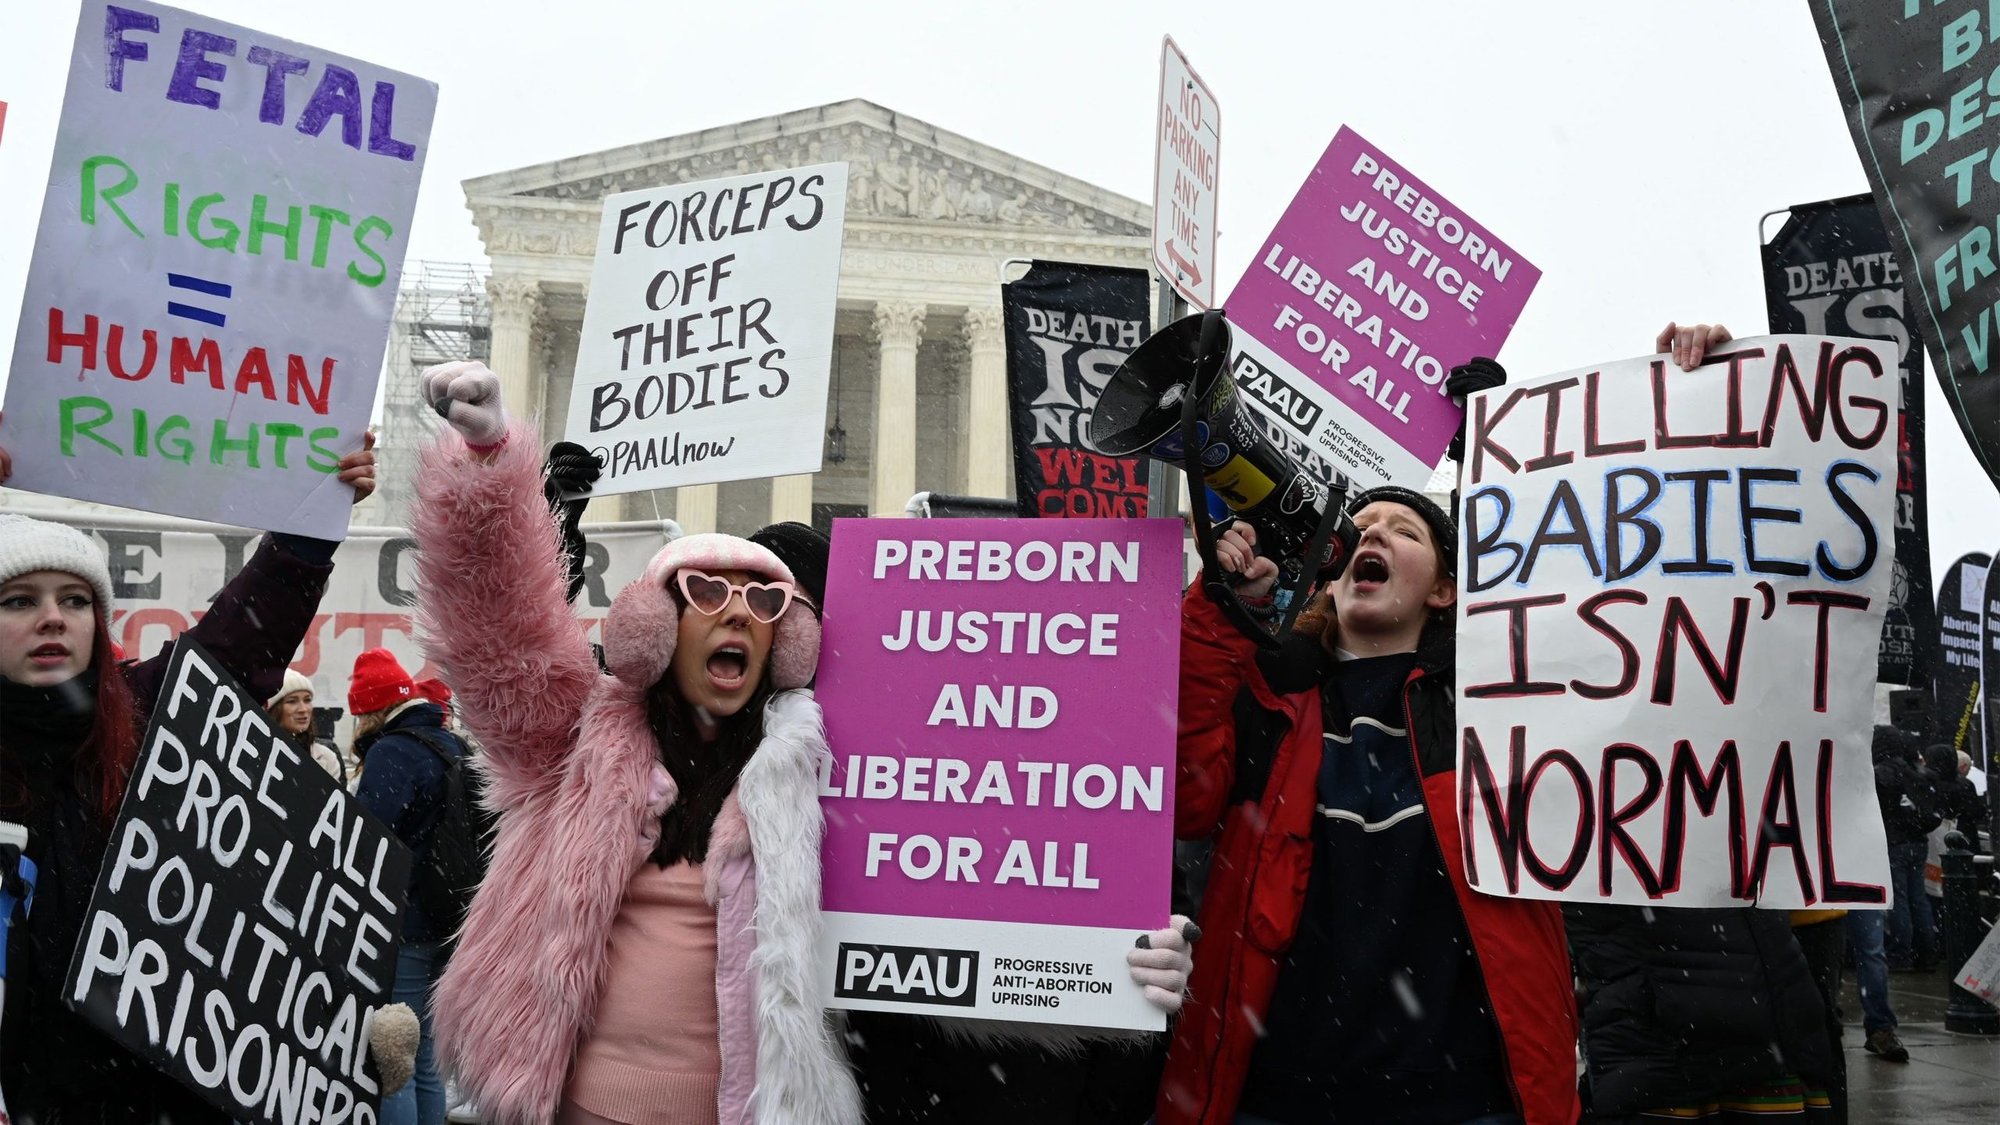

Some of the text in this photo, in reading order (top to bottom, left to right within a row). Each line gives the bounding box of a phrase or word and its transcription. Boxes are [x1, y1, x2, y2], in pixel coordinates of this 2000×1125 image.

[105, 5, 416, 161] FETAL
[1179, 77, 1201, 131] NO
[1164, 103, 1213, 192] PARKING
[613, 174, 824, 254] FORCEPS
[1173, 168, 1200, 215] ANY
[1351, 152, 1513, 284] PREBORN
[81, 156, 393, 288] RIGHTS
[1171, 199, 1200, 255] TIME
[646, 253, 735, 310] OFF
[1340, 200, 1483, 312] JUSTICE
[1784, 252, 1903, 297] DEATH
[1934, 214, 2000, 312] FR
[1347, 256, 1429, 321] AND
[612, 298, 778, 370] THEIR
[1023, 307, 1142, 348] DEATH
[47, 308, 337, 415] HUMAN
[1273, 305, 1411, 424] FOR ALL
[590, 349, 789, 433] BODIES
[1235, 357, 1317, 427] PAAU
[1470, 341, 1888, 483] KILLING
[59, 396, 340, 474] RIGHTS
[1230, 419, 1253, 451] 2,363?
[1235, 404, 1259, 443] What is
[1319, 436, 1359, 468] UPRISING
[1328, 420, 1386, 465] PROGRESSIVE
[1323, 428, 1392, 481] ANTI-ABORTION
[1464, 459, 1881, 592] BABIES
[873, 539, 1139, 583] PREBORN
[881, 610, 1119, 656] JUSTICE
[1463, 581, 1870, 712] ISN'T
[1940, 632, 1980, 651] Impacte
[1946, 650, 1980, 668] My Life
[926, 684, 1058, 729] AND
[167, 649, 397, 914] FREE ALL
[819, 754, 1163, 812] LIBERATION
[1463, 725, 1886, 906] NORMAL
[138, 725, 392, 993] PRO-LIFE
[865, 832, 1100, 890] FOR ALL
[108, 817, 378, 1093] POLITICAL
[843, 951, 971, 998] PAAU
[994, 958, 1093, 976] PROGRESSIVE
[991, 992, 1060, 1008] UPRISING
[993, 975, 1112, 995] ANTI-ABORTION
